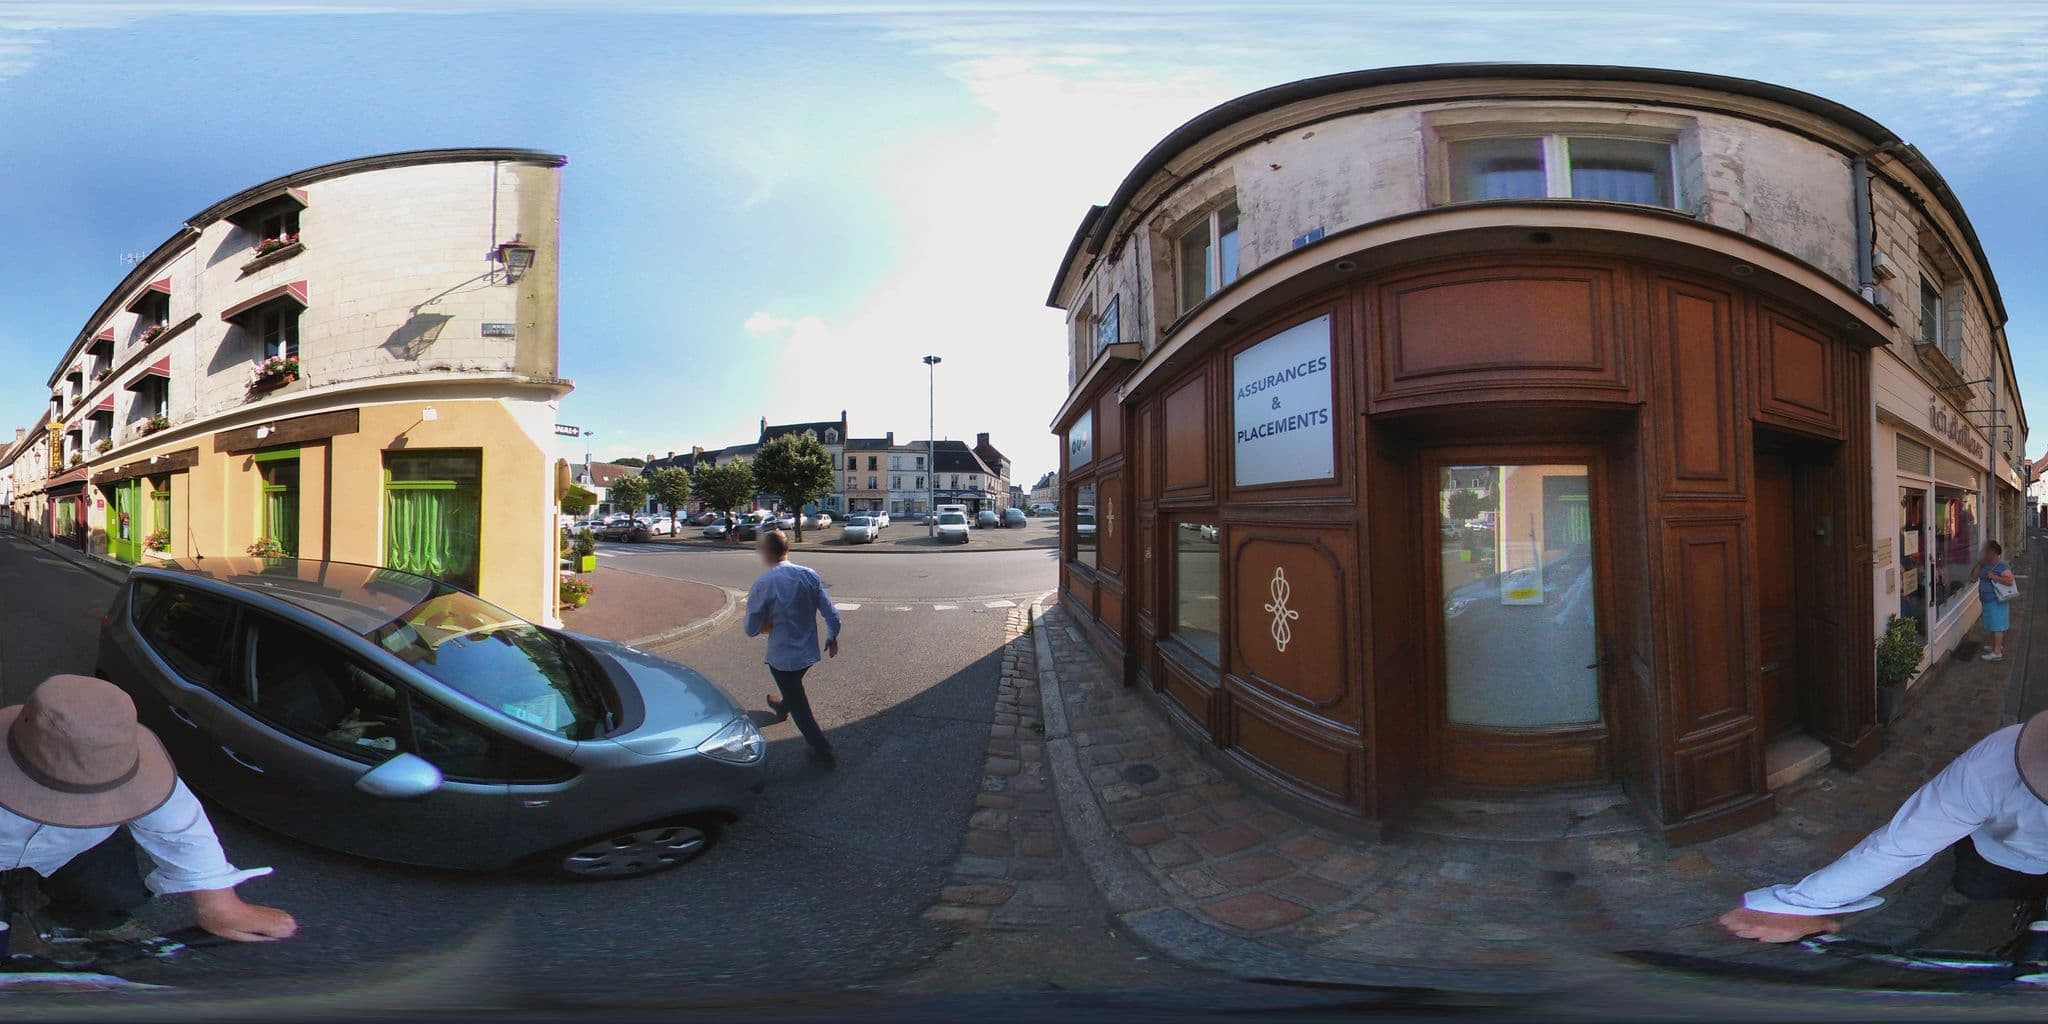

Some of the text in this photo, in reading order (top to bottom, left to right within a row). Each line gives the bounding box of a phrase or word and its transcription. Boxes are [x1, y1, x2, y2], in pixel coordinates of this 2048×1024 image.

[1237, 356, 1327, 400] ASSURANCES
[1271, 396, 1281, 410] &
[1237, 408, 1328, 443] PLACEMENTS
